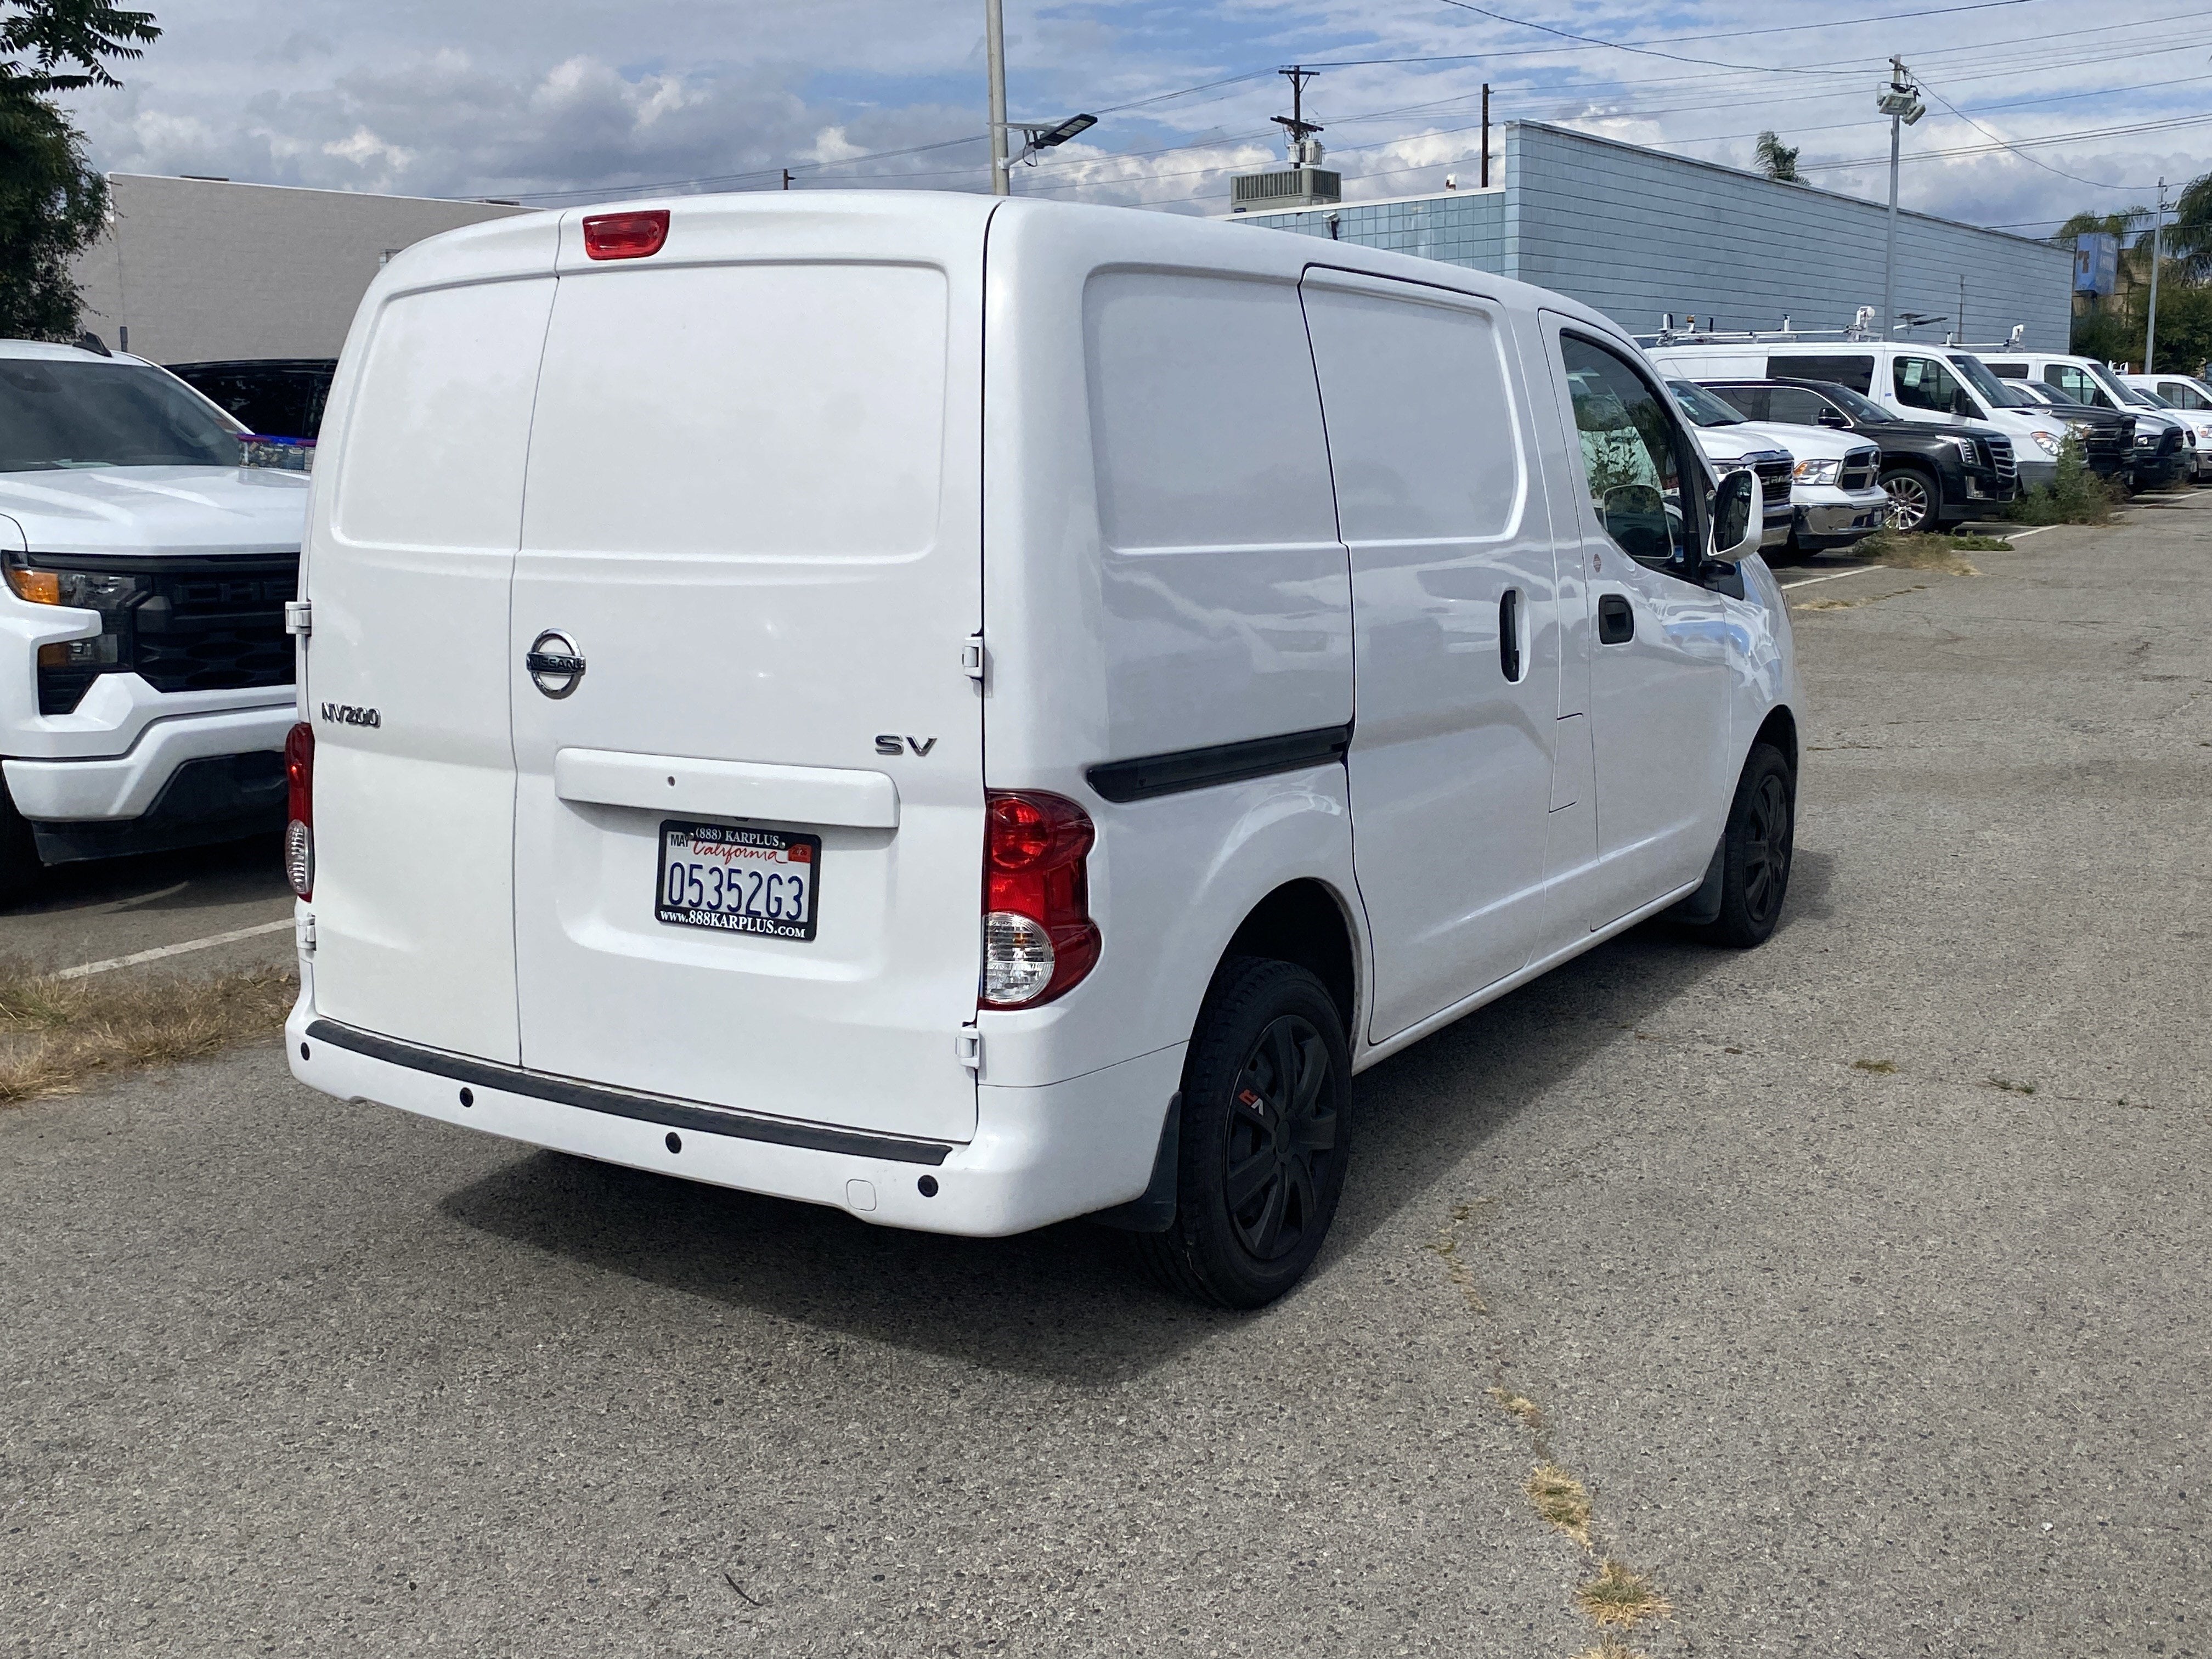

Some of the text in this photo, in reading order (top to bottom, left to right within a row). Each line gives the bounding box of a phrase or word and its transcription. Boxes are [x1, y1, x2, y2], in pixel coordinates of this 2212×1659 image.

[529, 654, 578, 672] NISSAN
[321, 702, 381, 729] NV200
[875, 734, 937, 757] SV
[670, 834, 689, 848] MAY
[696, 827, 779, 846] (888) KARPLUS
[693, 840, 788, 865] California
[668, 862, 803, 920] 05352G3
